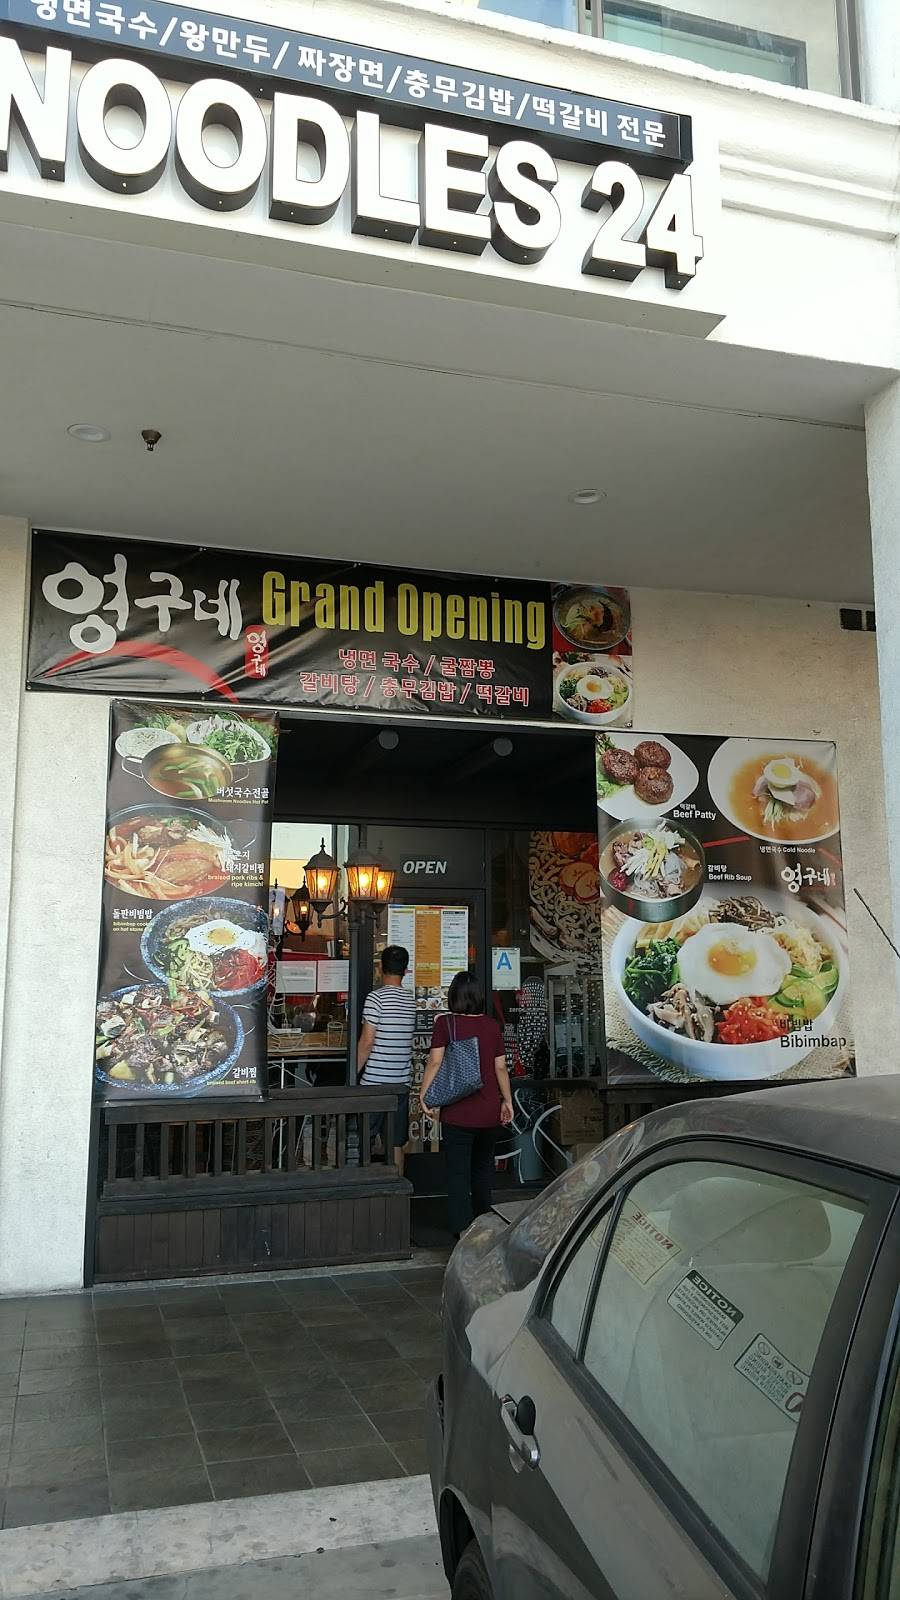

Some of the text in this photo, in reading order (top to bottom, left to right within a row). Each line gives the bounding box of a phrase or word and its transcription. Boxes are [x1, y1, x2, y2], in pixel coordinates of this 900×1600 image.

[617, 114, 667, 148] 전문
[0, 36, 704, 282] NOODLES 24
[42, 553, 240, 653] 엉구네
[262, 571, 546, 649] Grand Opening
[339, 649, 376, 671] 냉면
[382, 652, 421, 673] 국수
[440, 657, 495, 679] 굴짬뽕
[300, 672, 360, 695] 갈비탕
[380, 677, 457, 702] 충무김밥
[476, 684, 530, 706] 떡갈비
[216, 786, 270, 799] 버섯국수전골
[673, 810, 716, 821] Beef Patty
[403, 860, 448, 875] OPEN
[709, 873, 723, 881] Beef
[781, 863, 830, 893] 엉구네
[112, 908, 153, 919] 돌판비빔밥
[497, 951, 512, 970] A
[780, 1017, 813, 1031] 비빔밥
[781, 1034, 847, 1050] Bibimbap
[232, 1066, 257, 1078] 갈비찜
